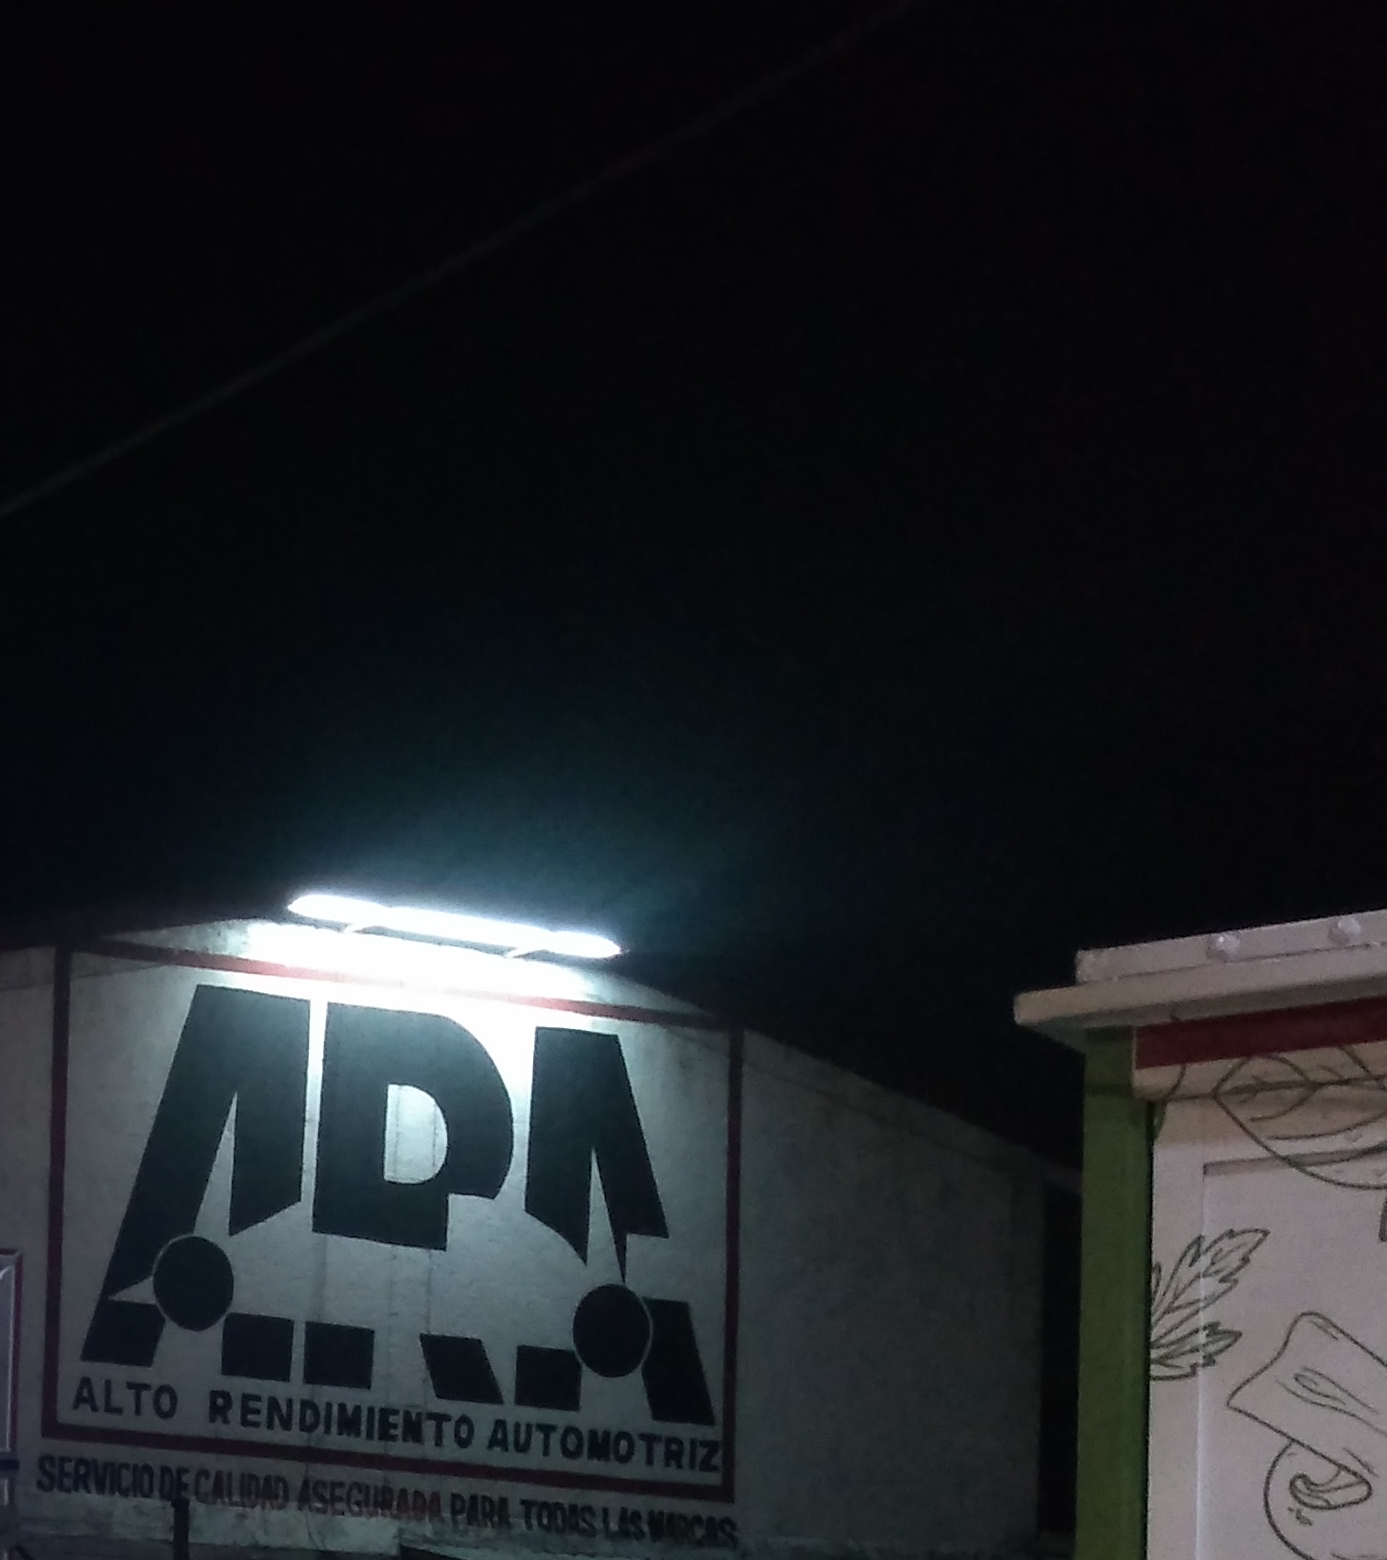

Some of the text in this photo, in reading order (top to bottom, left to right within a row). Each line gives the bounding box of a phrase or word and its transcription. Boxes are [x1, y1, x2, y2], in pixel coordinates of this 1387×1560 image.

[72, 1376, 721, 1473] ALTO RENDIMIENTO AUTOMOTRIZ
[36, 1454, 739, 1549] SERVICIO DE CALIDAD ASEGURADA PARA TODAS LAS MARCAS
